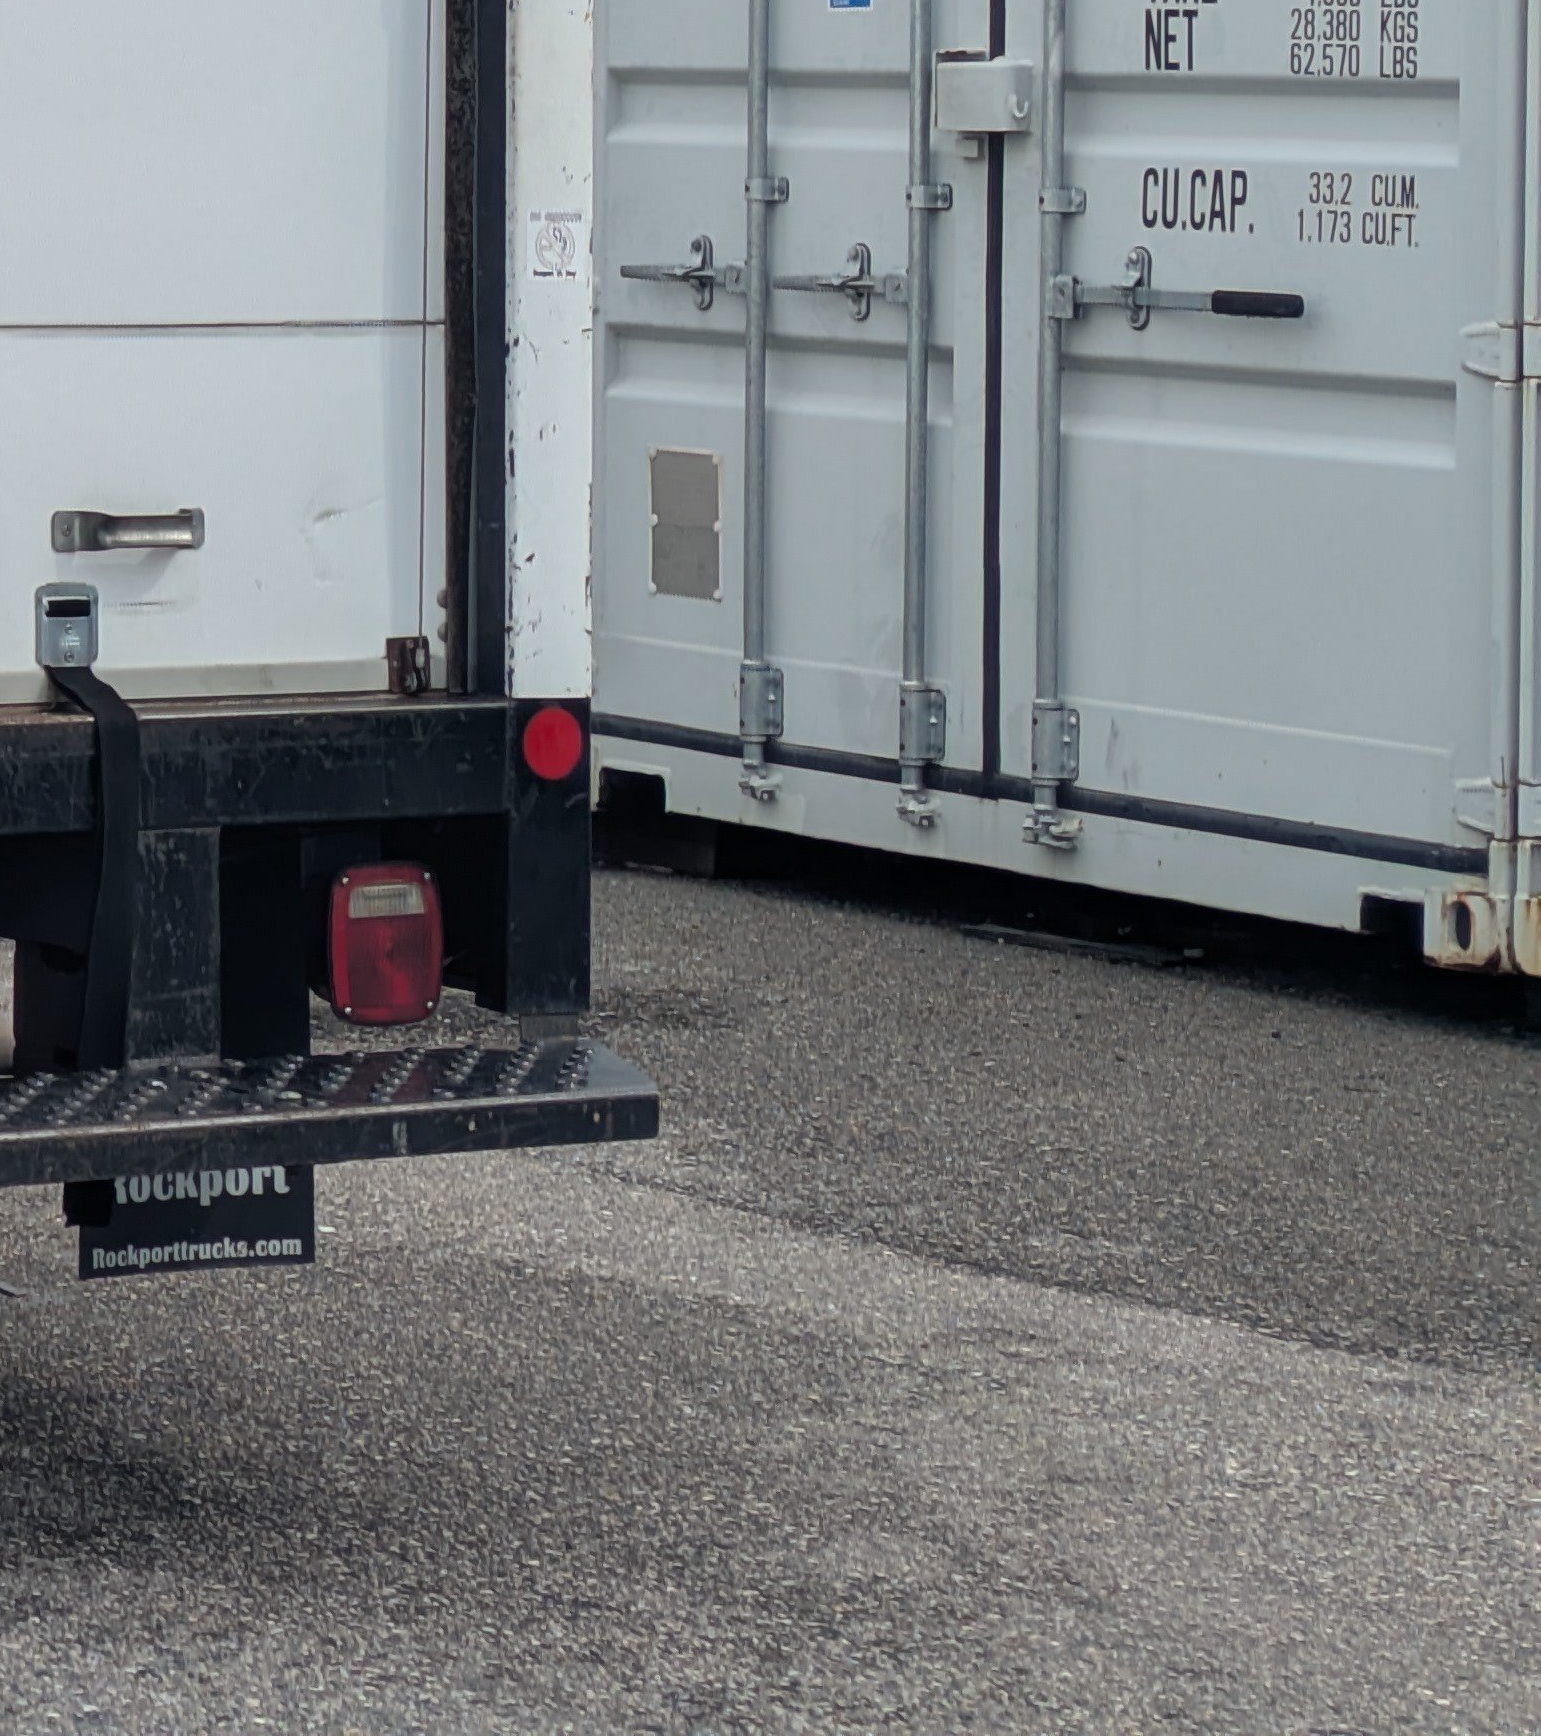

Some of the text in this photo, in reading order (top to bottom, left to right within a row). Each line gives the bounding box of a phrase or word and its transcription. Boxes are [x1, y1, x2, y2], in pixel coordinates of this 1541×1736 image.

[1145, 8, 1199, 71] NET
[1380, 10, 1419, 44] KGS
[1379, 45, 1418, 79] LBS
[92, 1237, 303, 1270] Rockporttrucks.com
